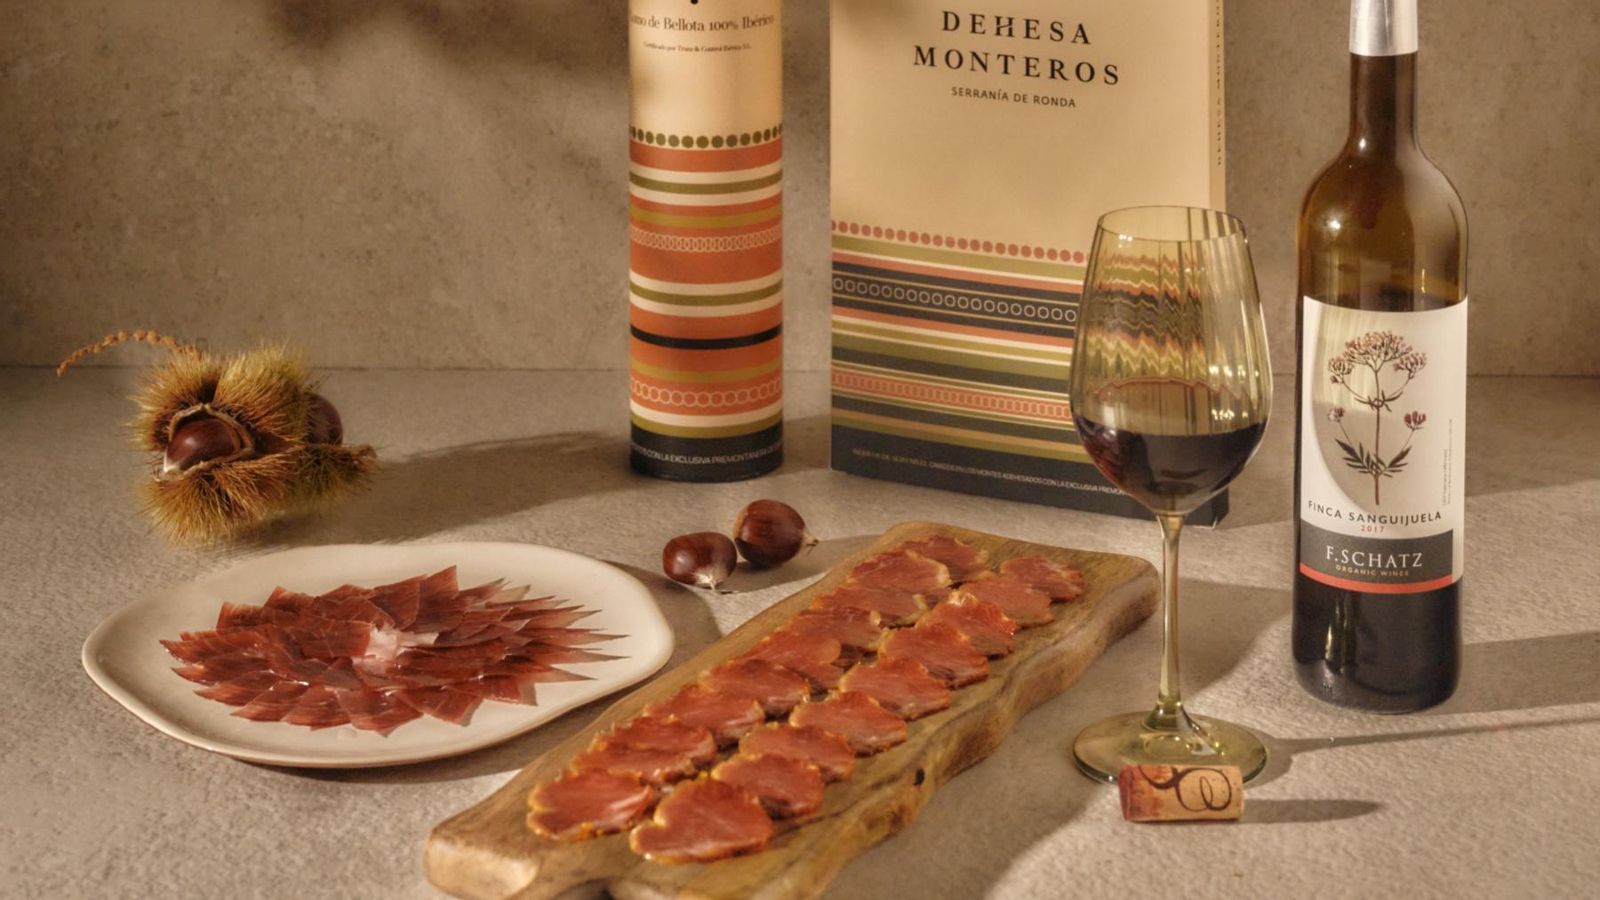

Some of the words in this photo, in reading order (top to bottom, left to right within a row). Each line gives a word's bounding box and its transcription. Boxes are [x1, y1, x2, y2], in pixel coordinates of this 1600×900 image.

[648, 15, 661, 28] de
[664, 16, 705, 32] Bellota
[709, 20, 738, 31] 100%
[942, 10, 1091, 45] DEHESA
[913, 45, 1119, 86] MONTEROS
[951, 86, 1010, 102] SERRANÍA
[1014, 93, 1029, 104] DE
[1033, 96, 1077, 108] RONDA
[1308, 500, 1342, 519] FINCA
[1349, 511, 1442, 526] SANGUIJUELA
[1361, 525, 1385, 533] 2017
[1335, 564, 1377, 576] ORGANIC
[1380, 569, 1409, 577] WINES
